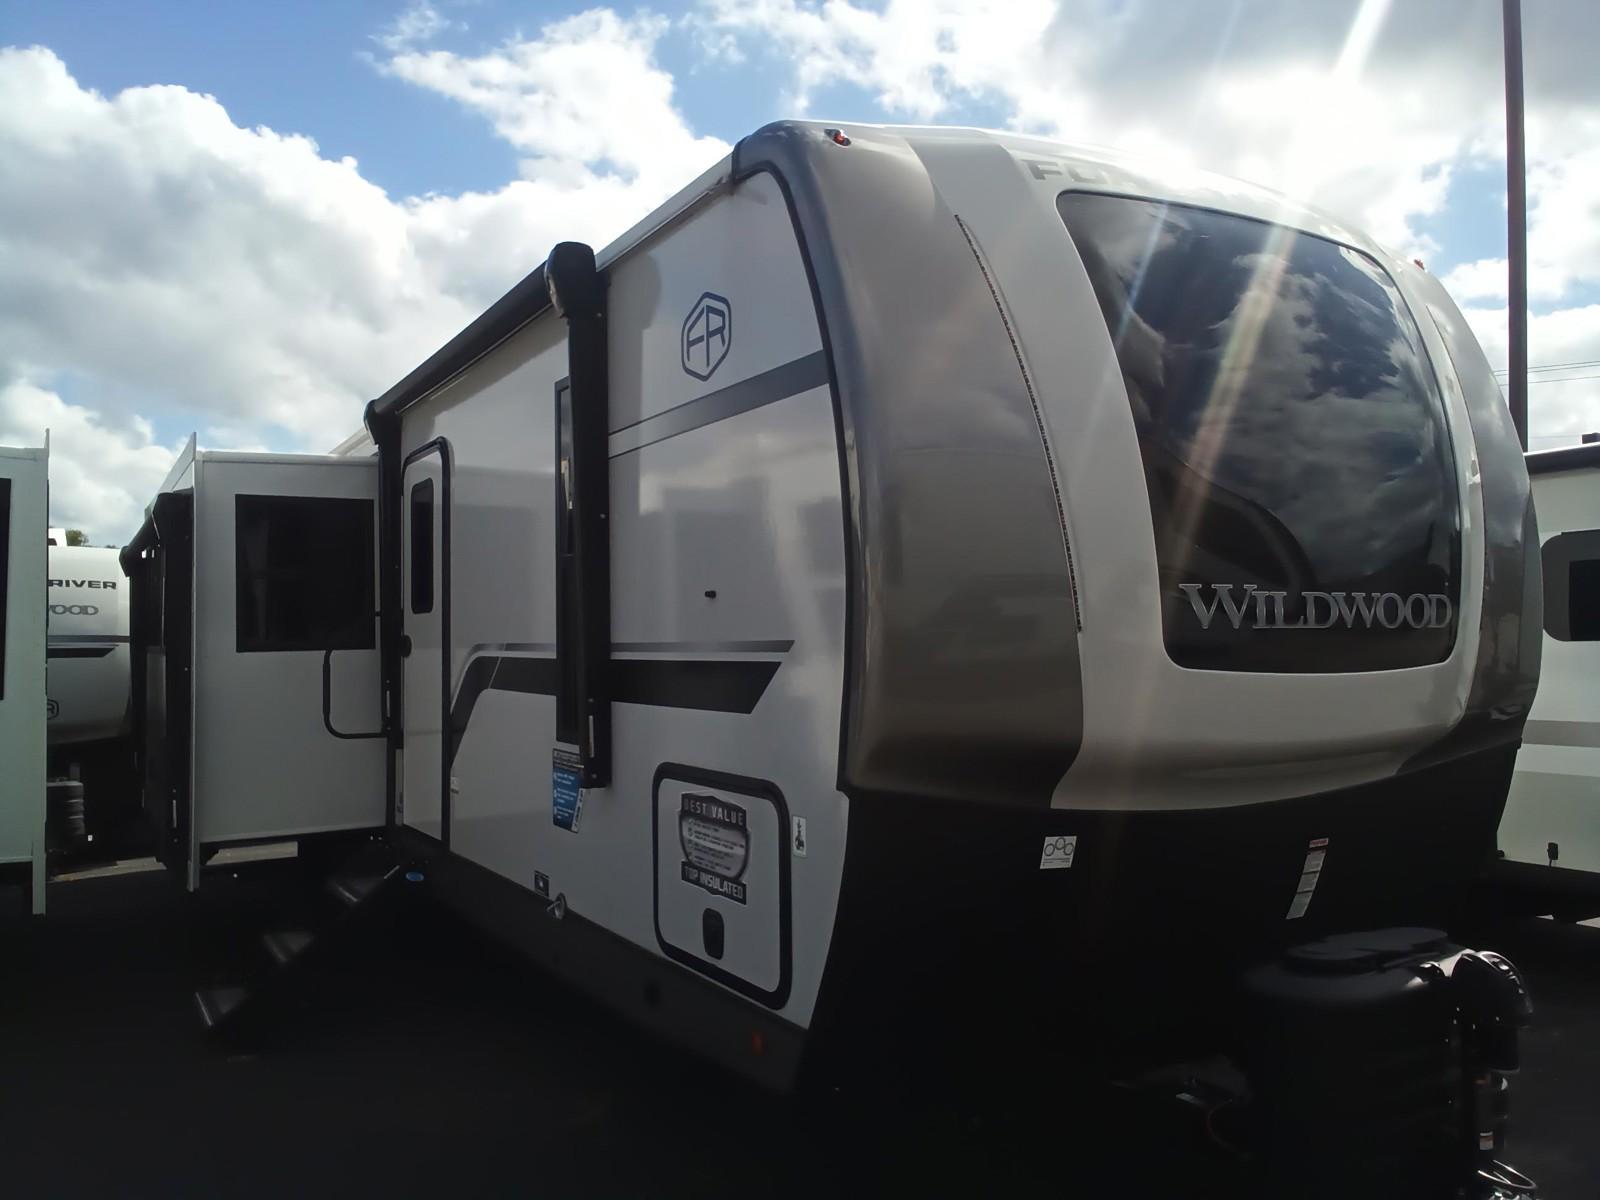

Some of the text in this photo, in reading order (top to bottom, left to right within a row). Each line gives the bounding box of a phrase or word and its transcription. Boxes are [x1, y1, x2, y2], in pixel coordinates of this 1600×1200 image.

[48, 579, 117, 589] RIVER
[49, 604, 99, 615] OOD
[1179, 583, 1451, 629] WILDWOOD
[683, 798, 744, 826] BEST VALUE
[699, 871, 744, 899] INSULATED
